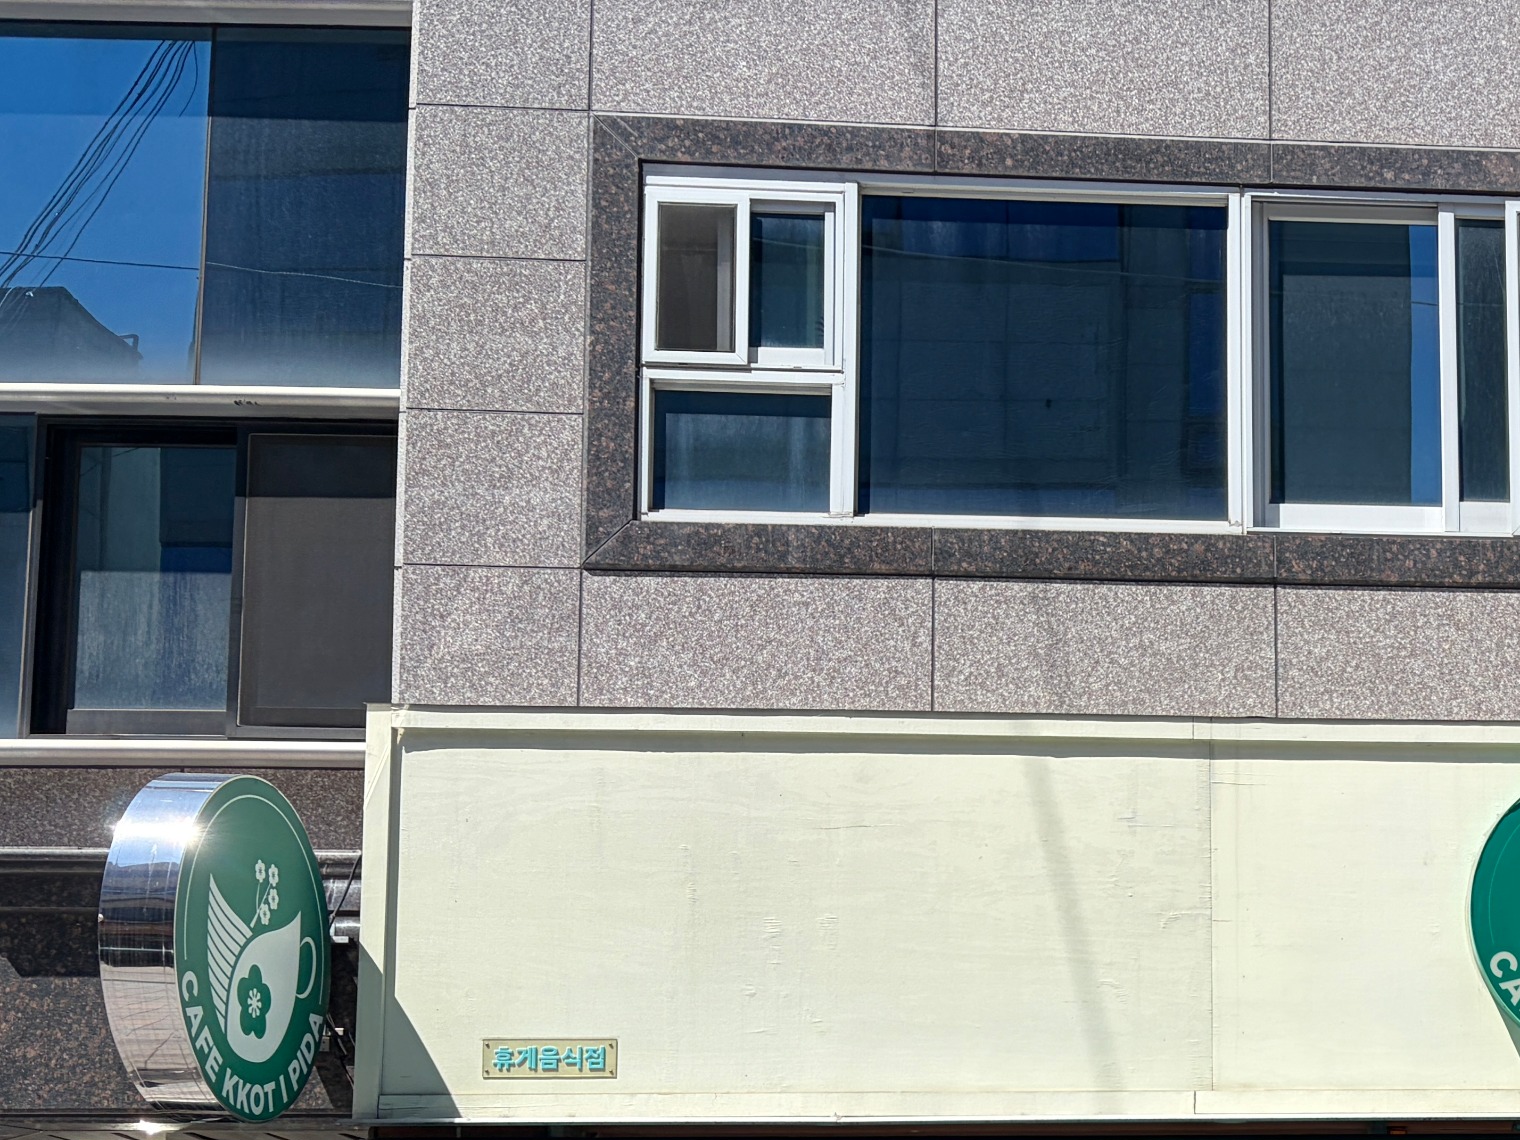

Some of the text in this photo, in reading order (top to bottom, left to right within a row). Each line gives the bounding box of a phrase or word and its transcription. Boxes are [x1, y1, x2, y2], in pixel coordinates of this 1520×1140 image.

[182, 970, 323, 1116] CAFE KKOT I PIDA
[492, 1046, 606, 1072] 휴게음식점
